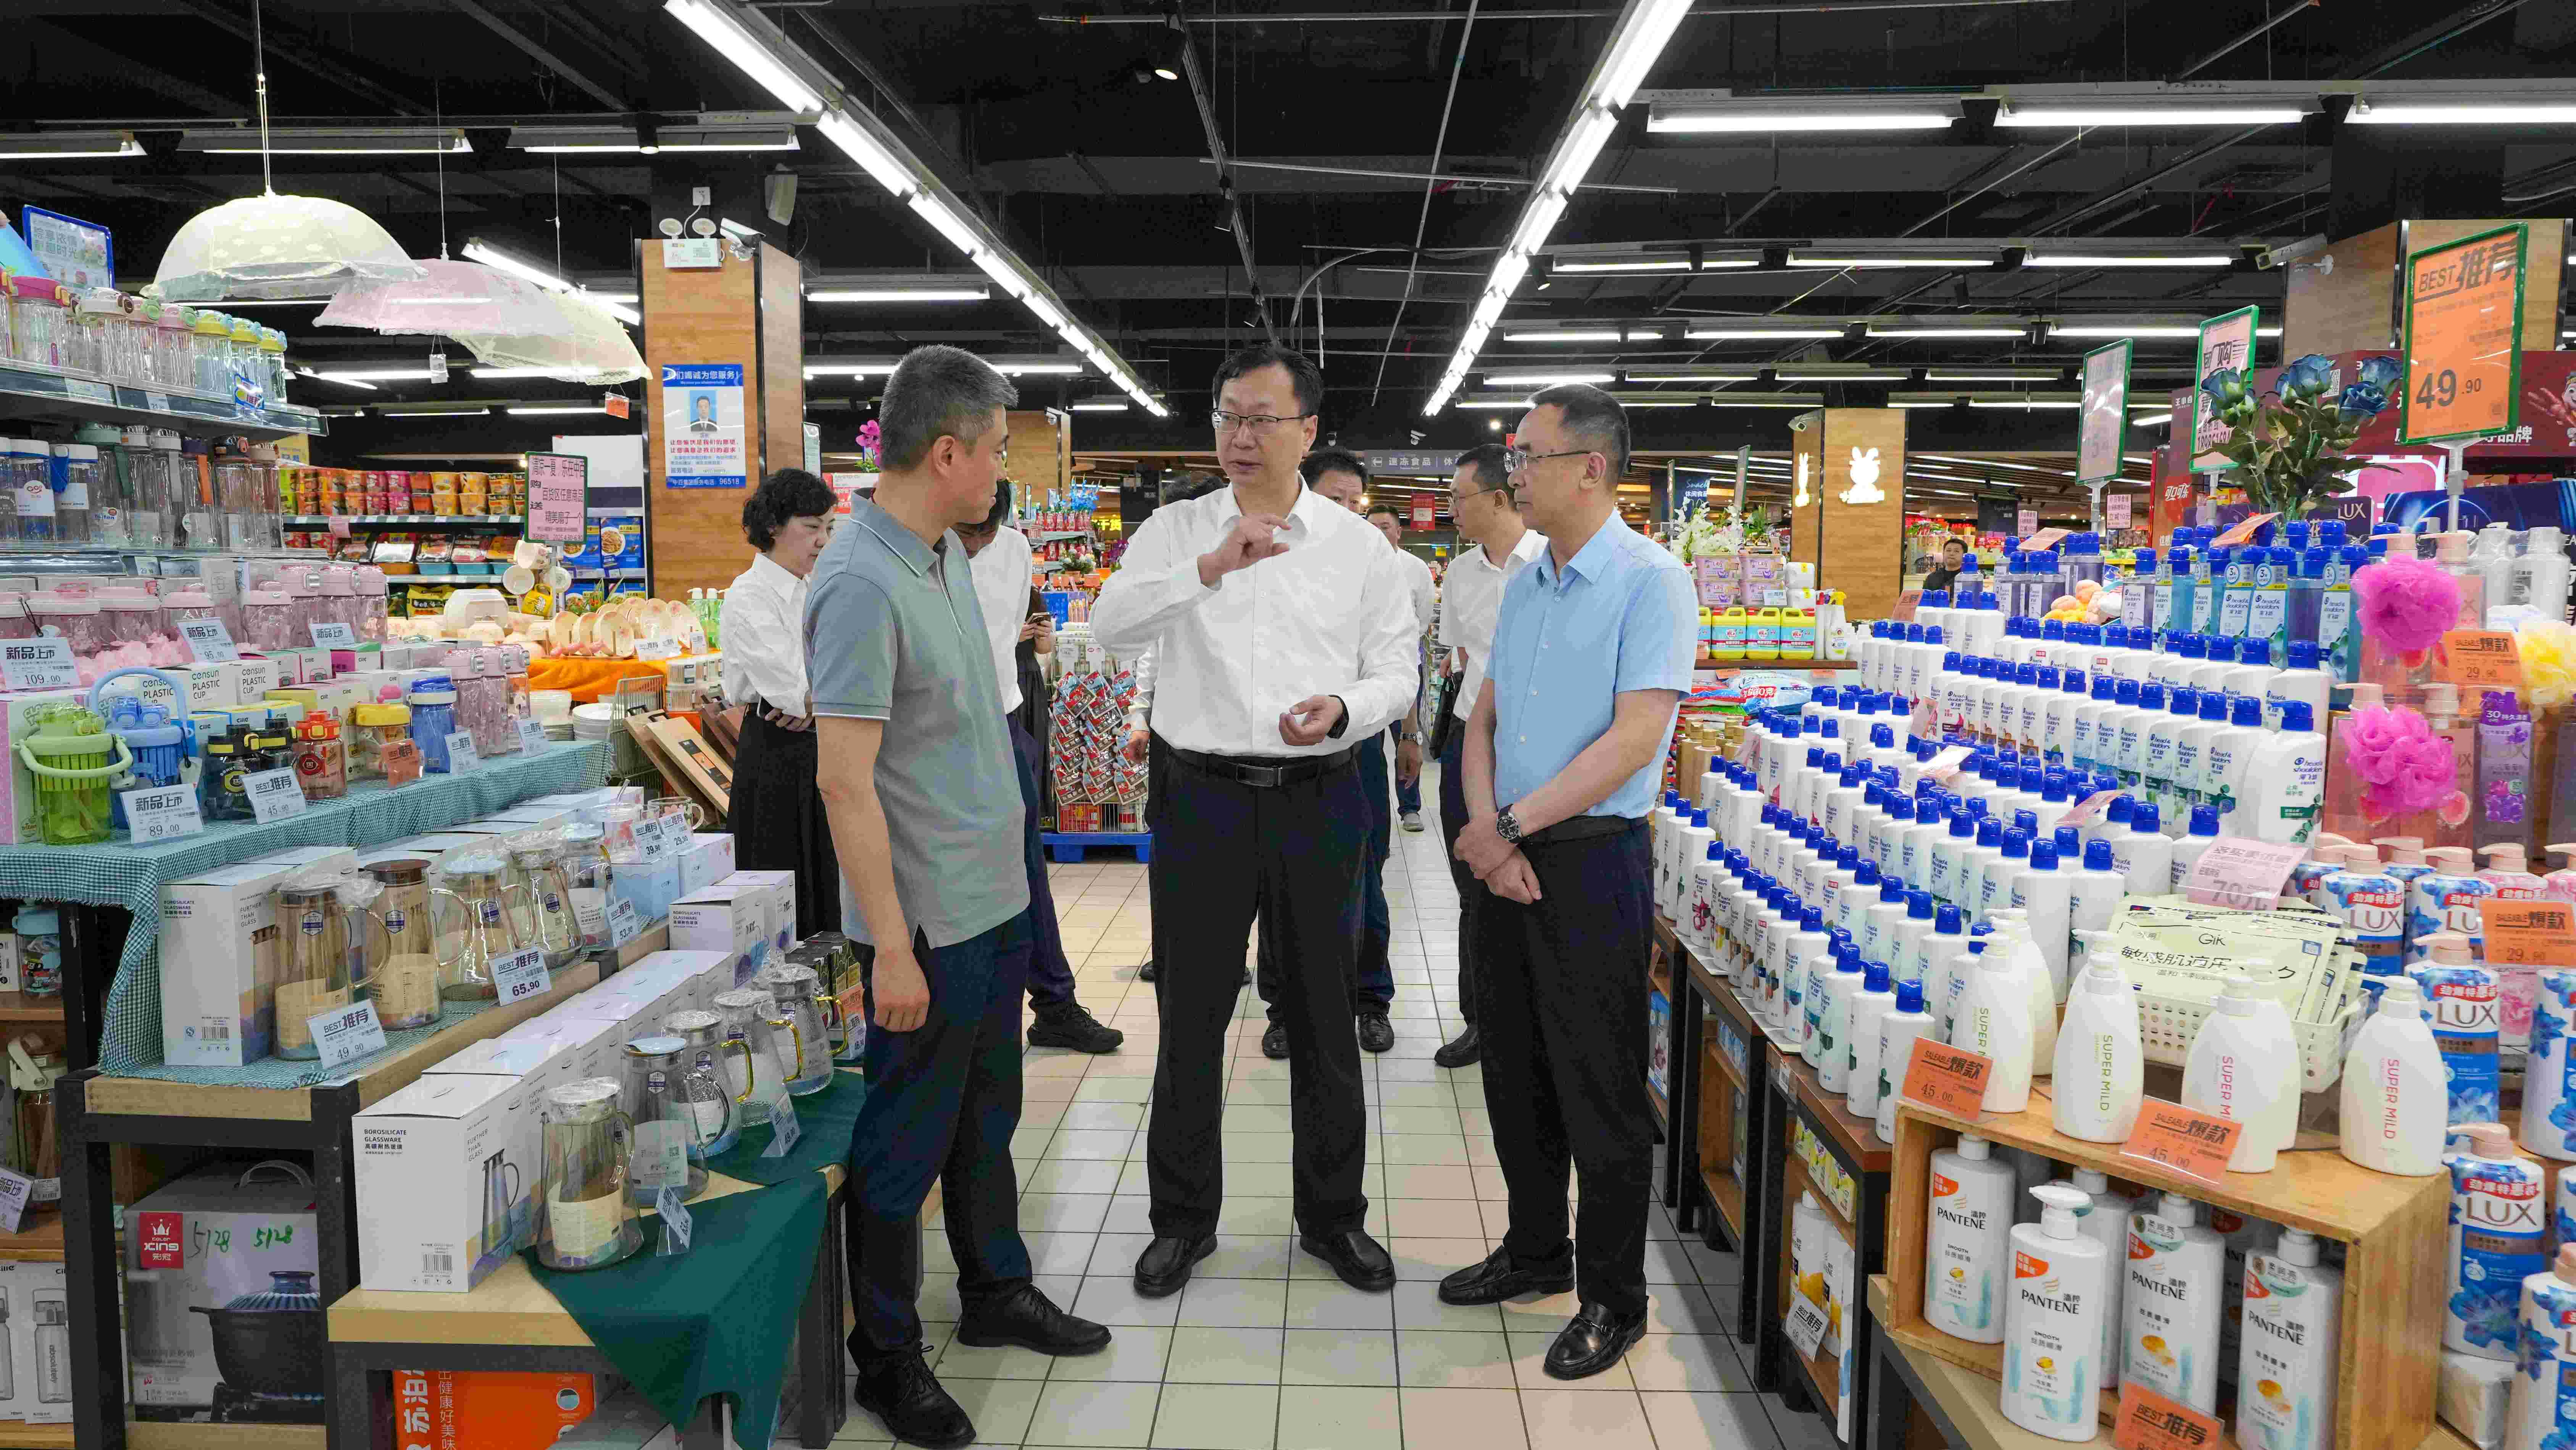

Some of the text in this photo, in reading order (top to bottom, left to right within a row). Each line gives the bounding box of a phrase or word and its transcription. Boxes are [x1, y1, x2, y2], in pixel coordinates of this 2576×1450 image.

[2419, 236, 2518, 293] BEST 推荐
[2416, 369, 2482, 410] 49.90
[1389, 457, 1431, 466] 速冻食品
[530, 480, 541, 489] 购
[2166, 483, 2191, 502] 可口可乐
[542, 487, 584, 502] 百货区任意商品
[530, 501, 543, 511] 送
[2338, 502, 2366, 520] LUX
[187, 627, 218, 639] 新品上市
[6, 646, 55, 660] 新品上市
[2479, 637, 2510, 653] 爆款
[25, 674, 61, 685] 109.00
[192, 669, 220, 681] censun
[242, 666, 266, 676] censun
[192, 679, 220, 690] PLASTIC
[242, 676, 266, 686] PLASTIC
[143, 687, 174, 699] PLASTIC
[193, 691, 206, 699] CUP
[243, 686, 254, 694] CUP
[256, 775, 292, 792] BEST 推荐
[135, 795, 182, 812] 新品上市
[268, 804, 289, 816] 45.90
[645, 821, 658, 833] 推荐
[672, 813, 683, 824] 推荐
[149, 824, 180, 837] 89.00
[646, 844, 661, 855] 39.90
[240, 902, 262, 914] FURTHER
[240, 911, 255, 921] THAN
[618, 900, 631, 915] 推荐
[240, 918, 257, 927] GLASS
[2350, 908, 2402, 932] LUX
[2528, 911, 2566, 930] 爆款
[498, 952, 539, 972] BEST 推荐
[512, 980, 540, 997] 65.90
[323, 1008, 369, 1034] BEST 推荐
[2437, 1004, 2497, 1029] LUX
[1978, 1007, 1989, 1047] SUPER
[337, 1043, 364, 1060] 49.90
[1924, 1050, 1984, 1080] SALEABLE 爆款
[2100, 1034, 2113, 1111] SUPER MILD
[2220, 1056, 2233, 1100] SUPER
[1921, 1082, 1954, 1103] 45.00
[2384, 1058, 2400, 1140] SUPER MILD
[467, 1128, 489, 1146] FURTHER
[2155, 1113, 2231, 1145] SALEABLE 爆款
[467, 1142, 482, 1155] THAN
[468, 1149, 484, 1163] GLASS
[1937, 1206, 1986, 1230] PANTENE
[2466, 1197, 2537, 1227] LUX
[253, 1224, 294, 1250] 5128
[1947, 1243, 1969, 1254] SMOOTH
[2132, 1269, 2186, 1302] PANTENE
[2021, 1289, 2080, 1315] PANTENE
[1797, 1305, 1823, 1332] BEST 推荐
[2034, 1330, 2060, 1342] SMOOTH
[2249, 1309, 2304, 1346] PANTENE
[48, 1344, 58, 1384] absolutely
[2136, 1403, 2208, 1445] BEST 推荐
